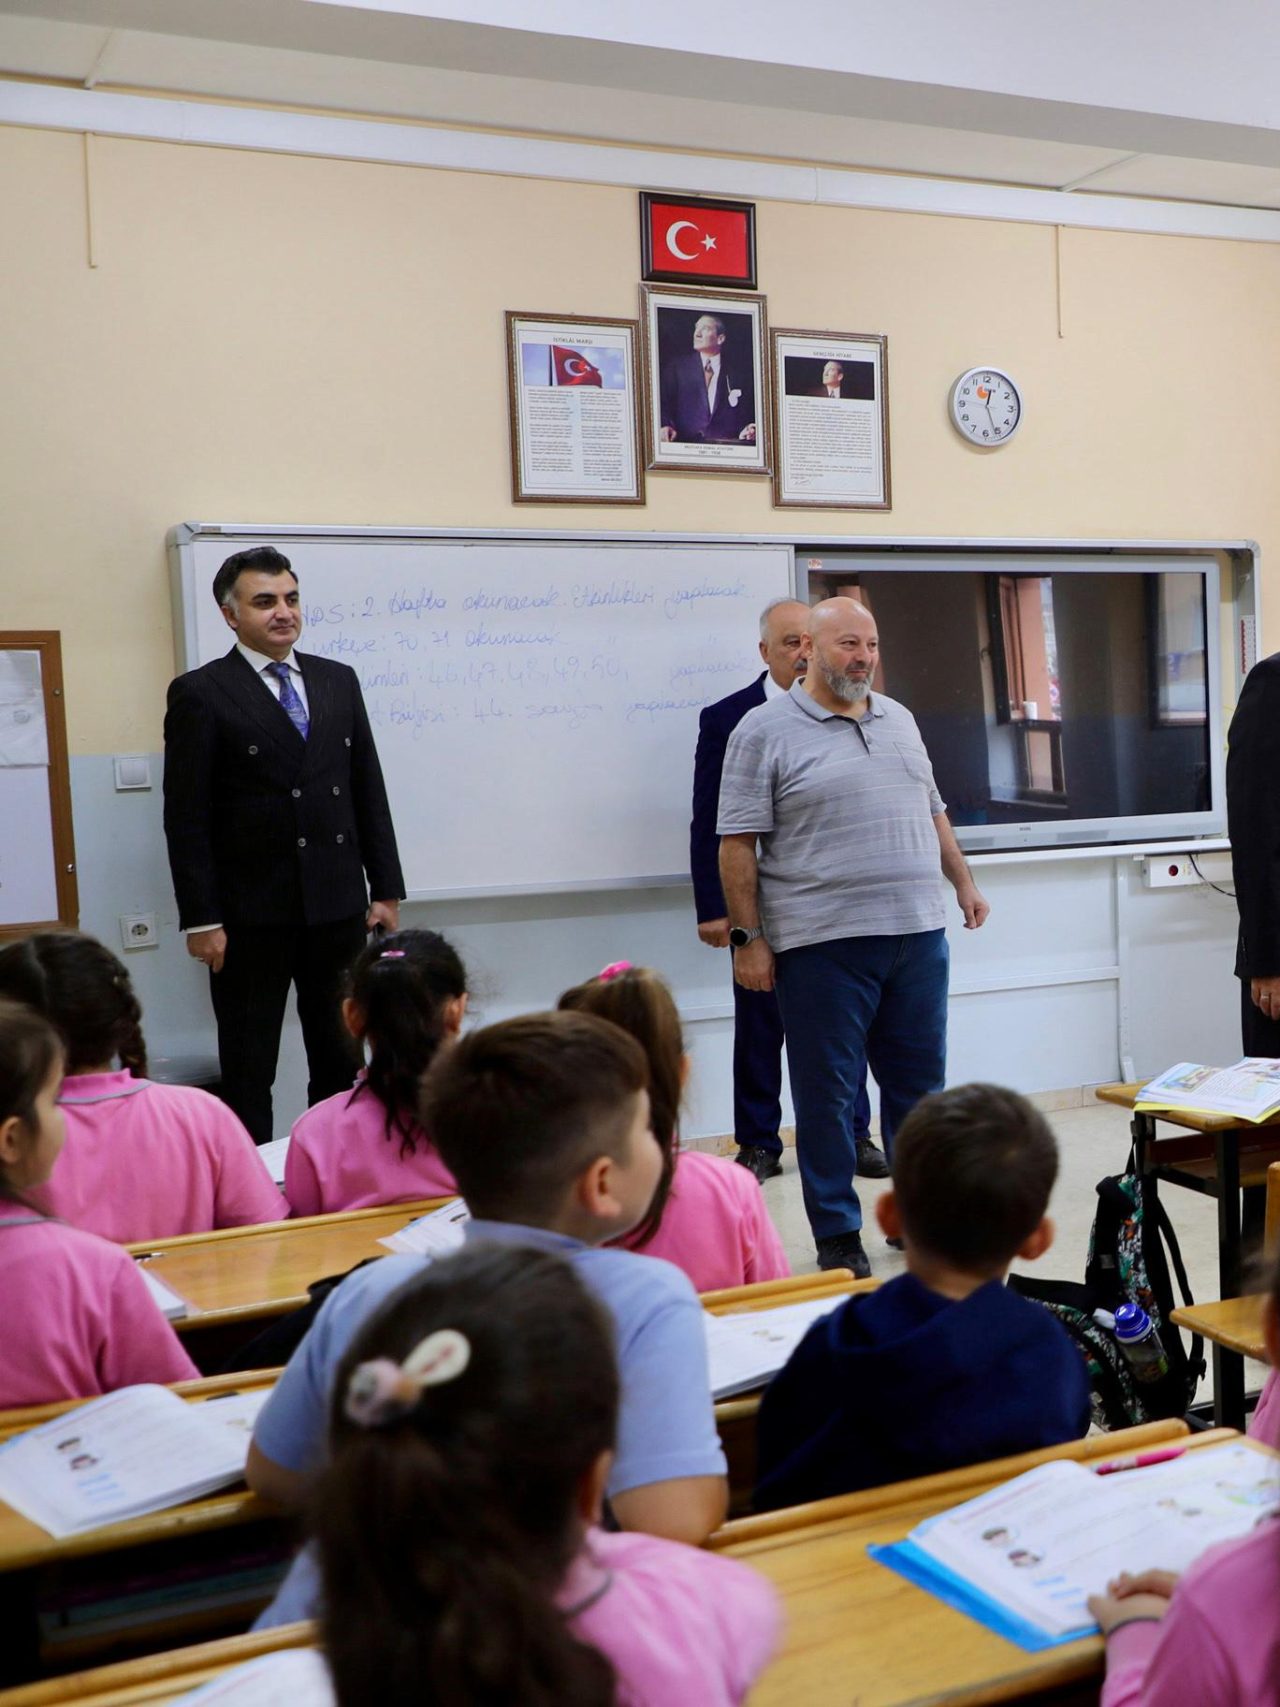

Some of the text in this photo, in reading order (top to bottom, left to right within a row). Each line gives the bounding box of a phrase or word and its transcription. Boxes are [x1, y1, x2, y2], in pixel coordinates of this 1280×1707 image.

[983, 376, 992, 384] 12
[1004, 392, 1010, 400] 2
[1007, 405, 1014, 413] 3
[982, 429, 989, 438] 6
